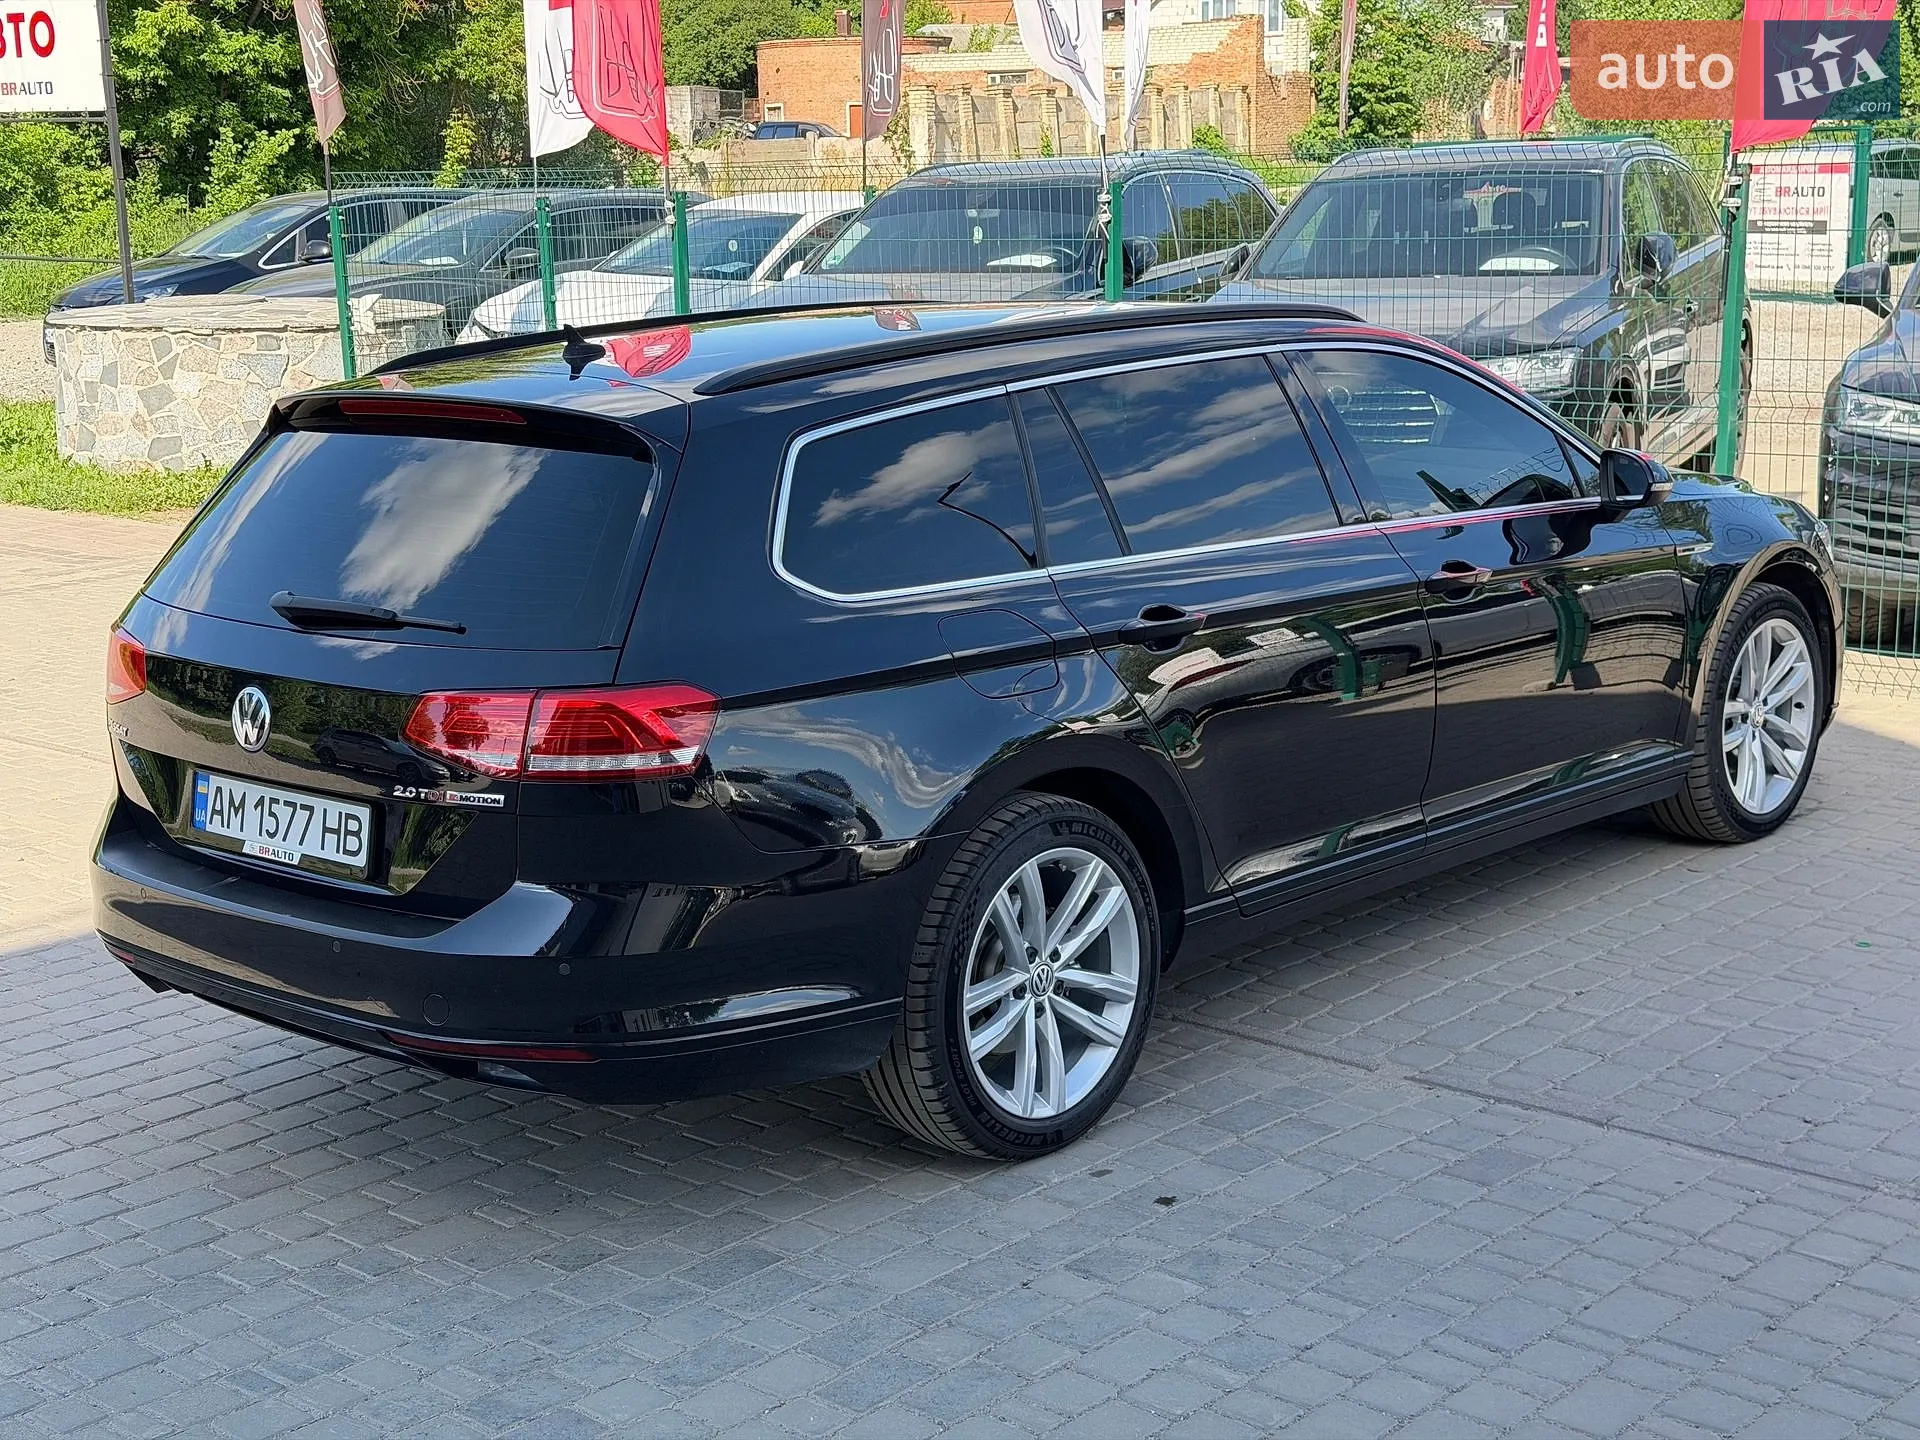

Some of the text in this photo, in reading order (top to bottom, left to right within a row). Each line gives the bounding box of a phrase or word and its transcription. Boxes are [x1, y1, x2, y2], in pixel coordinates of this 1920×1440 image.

[1, 81, 53, 95] BRAUTO
[1775, 186, 1825, 198] BRAUTO
[195, 808, 206, 822] UA
[208, 786, 363, 857] AM 1577 HB
[258, 845, 294, 862] BRAUTO
